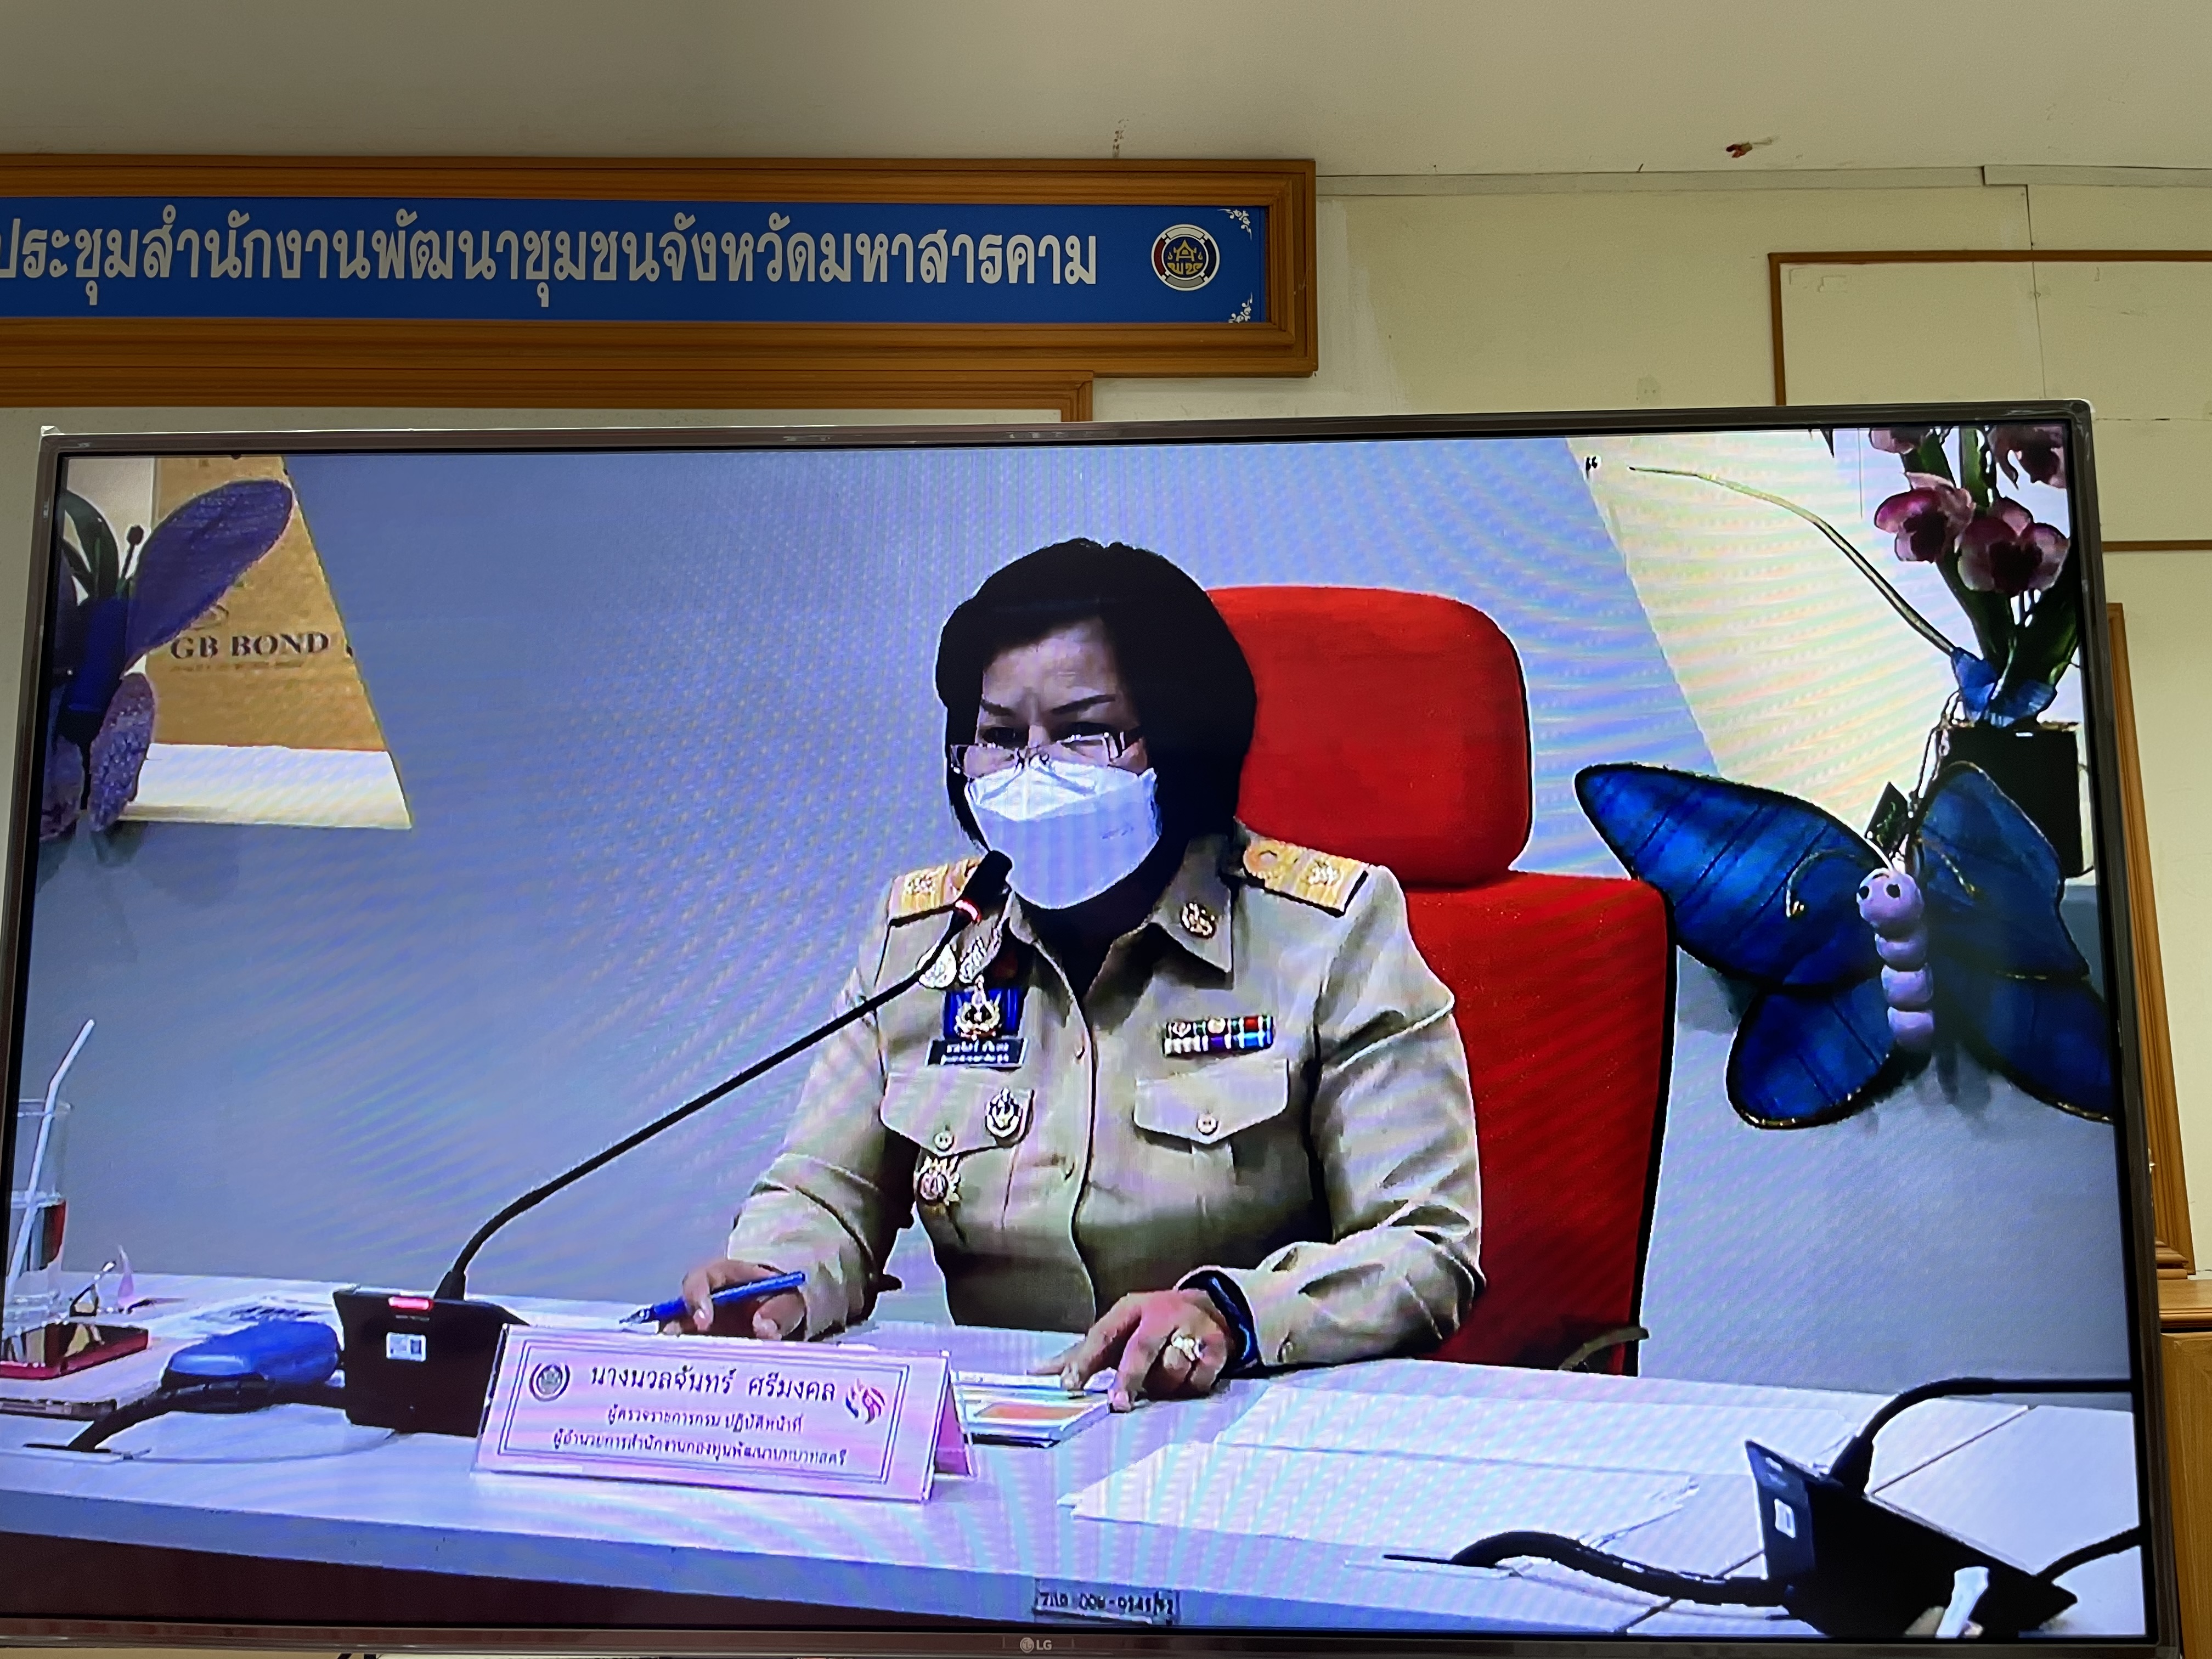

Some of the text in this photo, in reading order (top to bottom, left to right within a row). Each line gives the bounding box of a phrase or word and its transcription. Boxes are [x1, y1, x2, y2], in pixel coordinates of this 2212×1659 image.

[170, 631, 330, 659] GB BOND
[748, 1371, 836, 1401] ศรีมงคล
